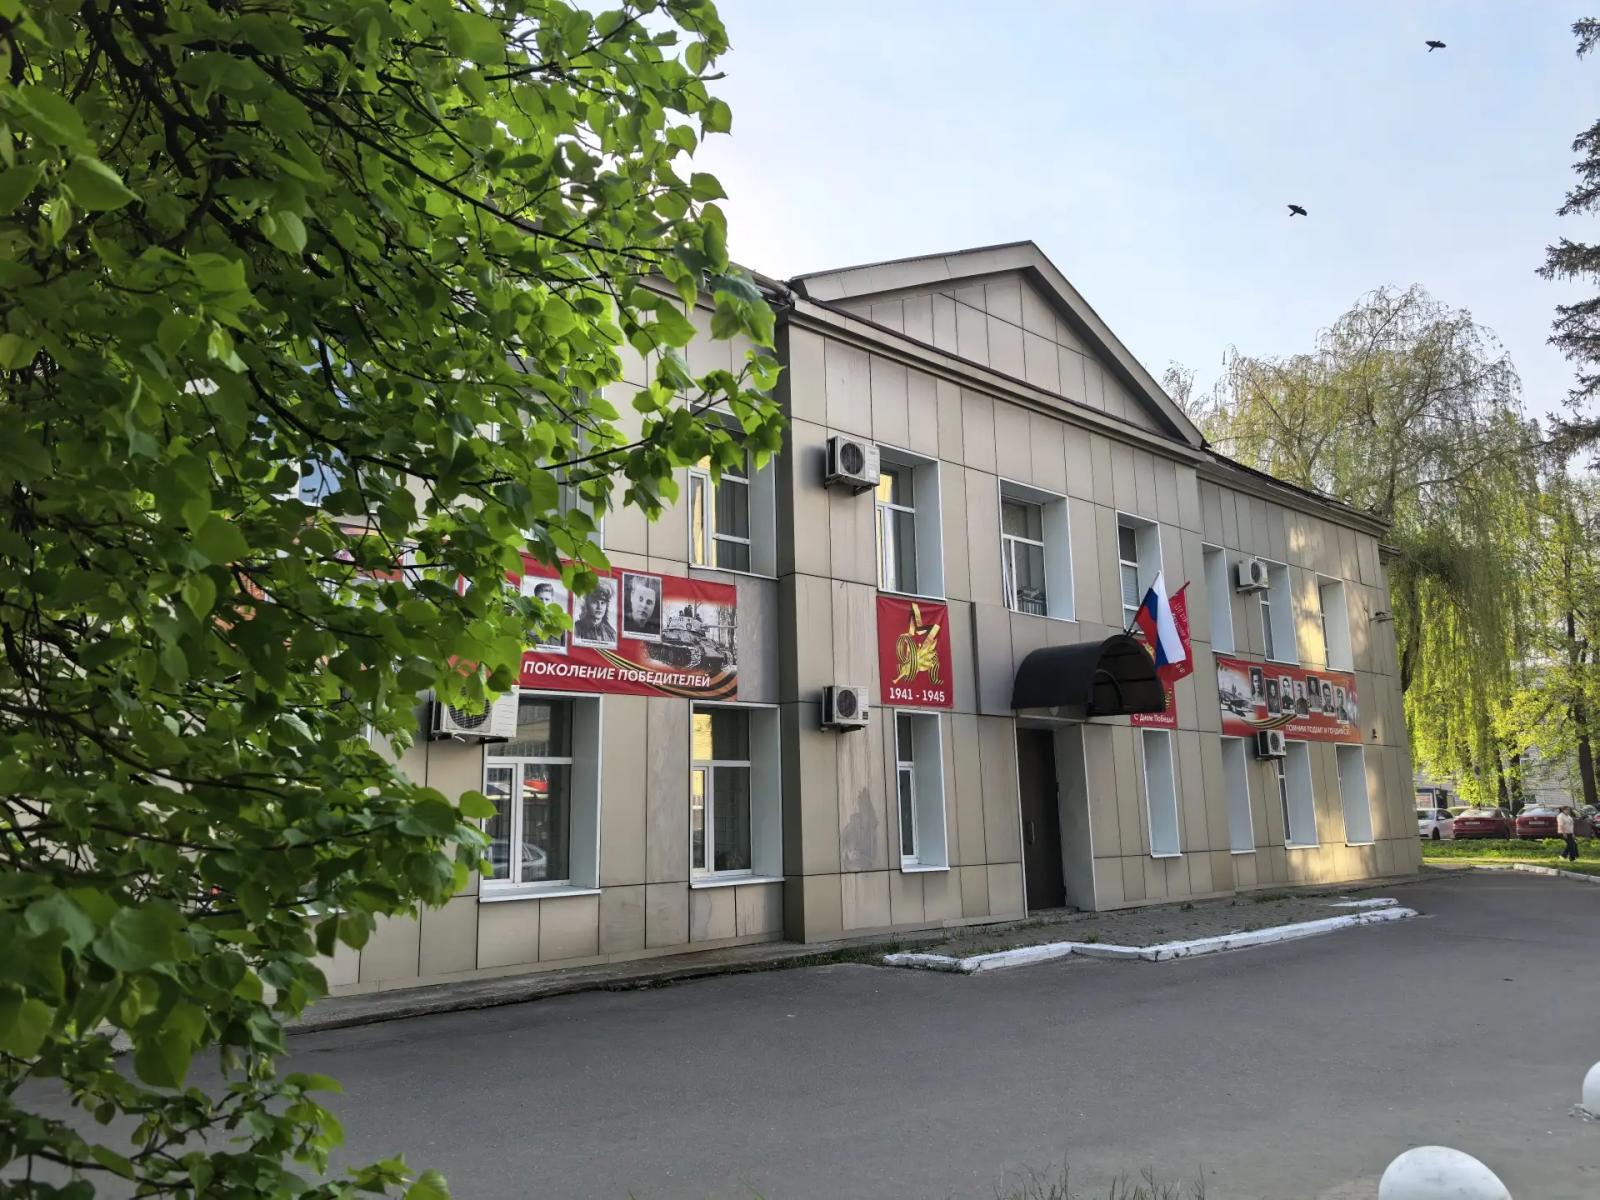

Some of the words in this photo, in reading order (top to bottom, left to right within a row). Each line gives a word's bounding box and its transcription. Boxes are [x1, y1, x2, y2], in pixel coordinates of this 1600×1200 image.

[523, 661, 615, 680] ПОКОЛЕНИЕ
[618, 669, 711, 688] ПОБЕДИТЕЛЕЙ
[889, 687, 913, 700] 1941
[922, 690, 945, 702] 1945
